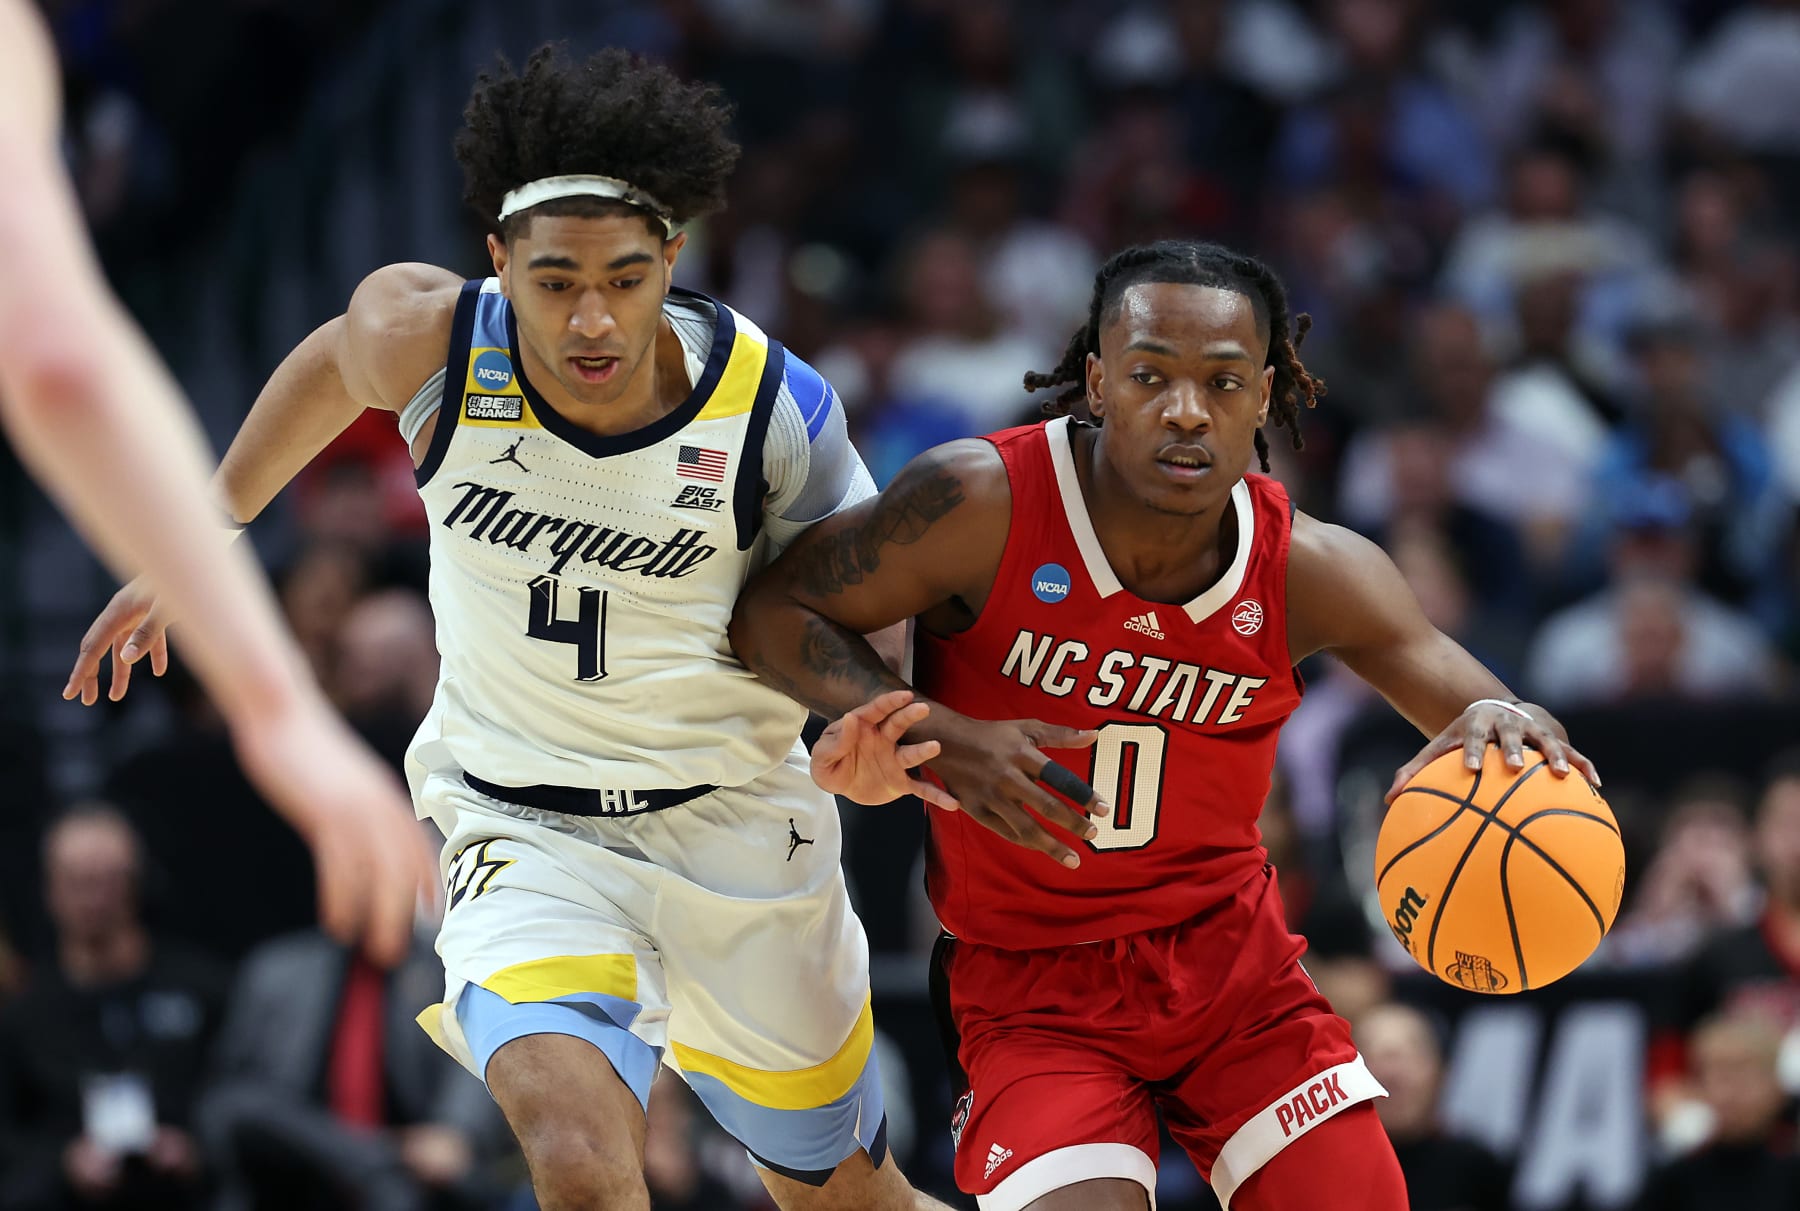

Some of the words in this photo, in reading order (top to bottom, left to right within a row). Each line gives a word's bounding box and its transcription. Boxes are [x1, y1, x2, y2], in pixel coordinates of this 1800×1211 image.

[477, 367, 510, 383] NCAA
[467, 407, 521, 419] CHANGE
[675, 494, 726, 509] EAST
[681, 485, 718, 498] BIG
[443, 481, 718, 578] Marquette
[1036, 581, 1068, 595] NCAA
[1235, 610, 1263, 621] ACC
[525, 574, 609, 682] 4
[1123, 619, 1166, 641] adidas
[1000, 629, 1089, 697] NC
[1087, 649, 1270, 726] STATE
[1083, 719, 1170, 853] 0
[1275, 1072, 1349, 1138] PACK
[983, 1148, 1014, 1180] adidas
